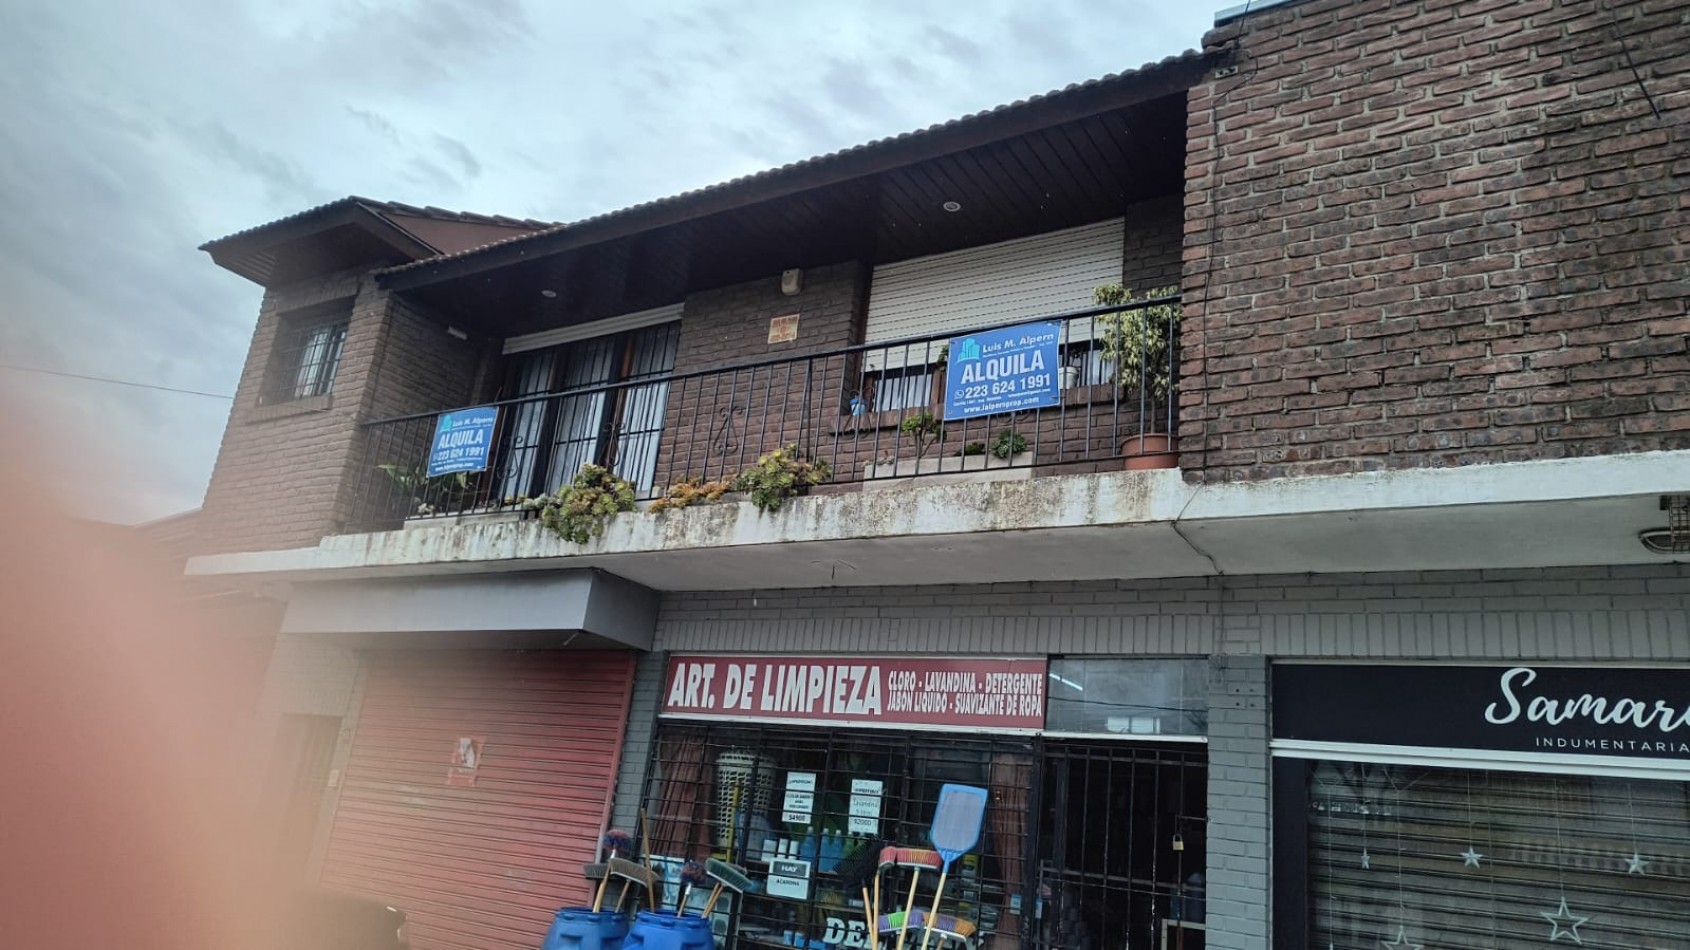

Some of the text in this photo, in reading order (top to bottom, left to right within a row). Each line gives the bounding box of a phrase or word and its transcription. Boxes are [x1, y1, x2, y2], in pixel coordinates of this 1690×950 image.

[982, 344, 1002, 353] Luis
[1004, 339, 1017, 349] M.
[1019, 334, 1055, 346] Alpern
[961, 350, 1045, 385] ALQUILA
[965, 384, 989, 399] 223
[992, 380, 1016, 395] 624
[1019, 373, 1051, 390] 1991
[437, 429, 484, 450] ALQUILA
[667, 662, 882, 716] ART. DE LIMPIEZA
[888, 670, 1043, 695] CLORO LAVANDINA DETERGENTE
[887, 690, 1042, 717] JABON LIQUIDO SUAVIZANTE DE ROPA
[1484, 667, 1690, 732] Samar
[1536, 737, 1690, 753] INDUMENTARIA
